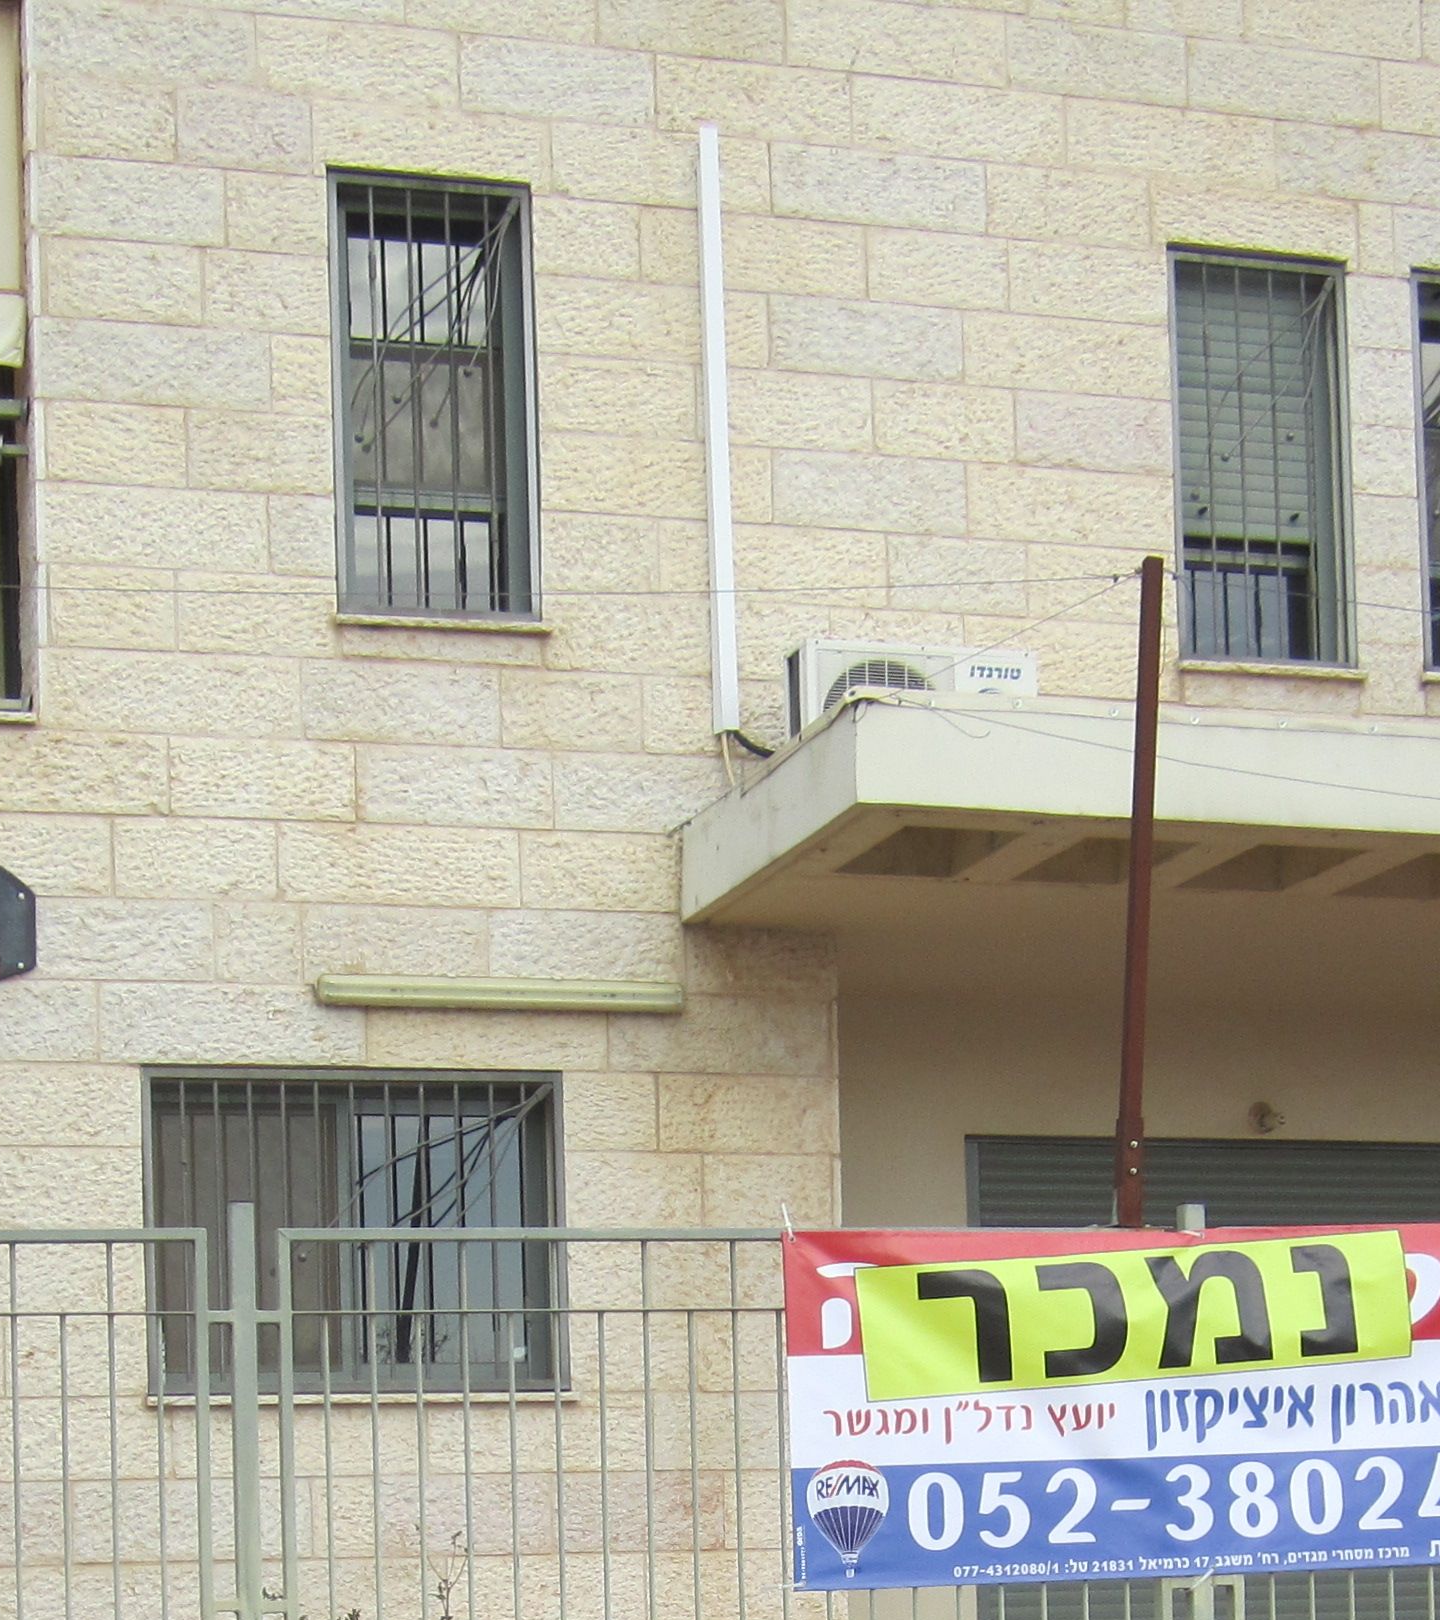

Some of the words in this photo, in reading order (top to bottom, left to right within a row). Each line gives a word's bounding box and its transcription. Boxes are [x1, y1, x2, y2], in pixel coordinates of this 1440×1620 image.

[970, 665, 1021, 680] טורנדו
[917, 1243, 1359, 1383] נמכר
[822, 1407, 930, 1437] ומגשר
[944, 1400, 1032, 1445] נדל"ן
[1047, 1402, 1116, 1437] יועץ
[1145, 1384, 1315, 1451] איציקזון
[815, 1474, 880, 1501] RE/MAX
[1283, 1551, 1328, 1565] מגדים,
[1332, 1549, 1374, 1562] מסחרי
[1378, 1546, 1410, 1559] מרכז
[1092, 1560, 1133, 1572] 21831
[1138, 1556, 1189, 1571] כרמיאל
[1193, 1557, 1209, 1568] 17
[1214, 1554, 1253, 1567] משגב
[953, 1560, 1060, 1577] 077-4312080/1
